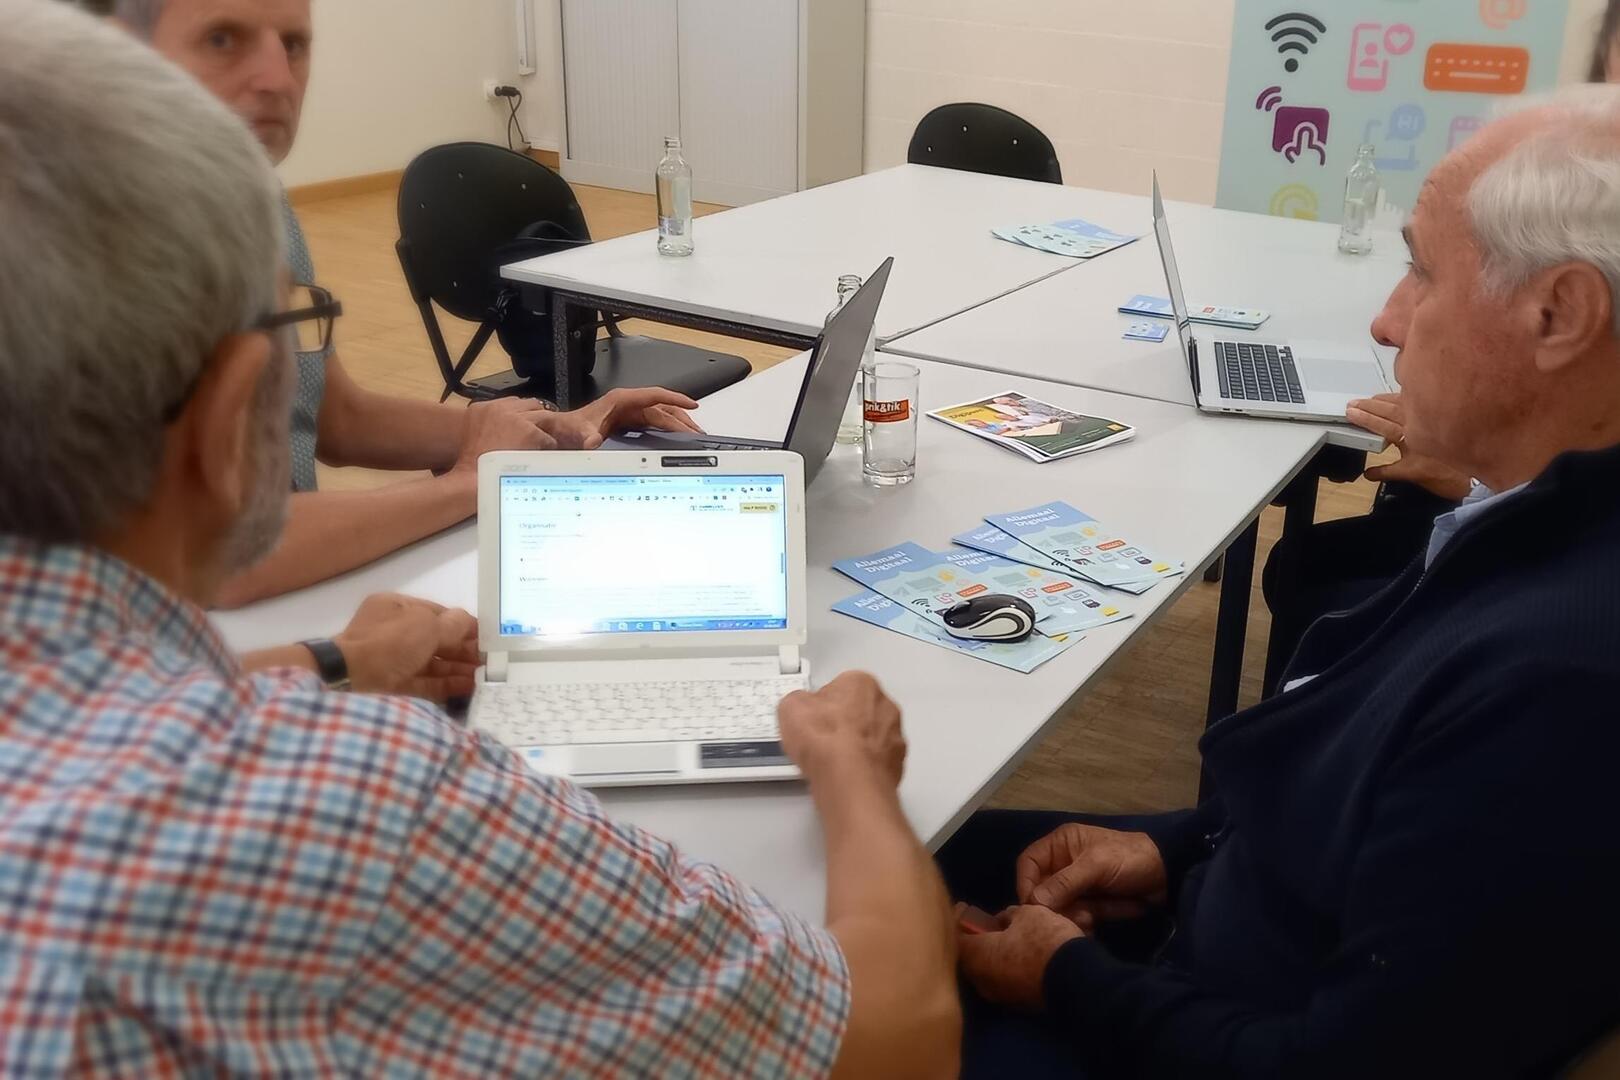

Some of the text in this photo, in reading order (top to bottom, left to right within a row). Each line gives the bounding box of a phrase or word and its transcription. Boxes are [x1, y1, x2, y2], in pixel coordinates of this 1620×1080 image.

[1006, 508, 1055, 522] Allemaal
[1014, 513, 1060, 527] Digitaal
[855, 550, 906, 568] Allemaal
[864, 556, 912, 573] Digitaal
